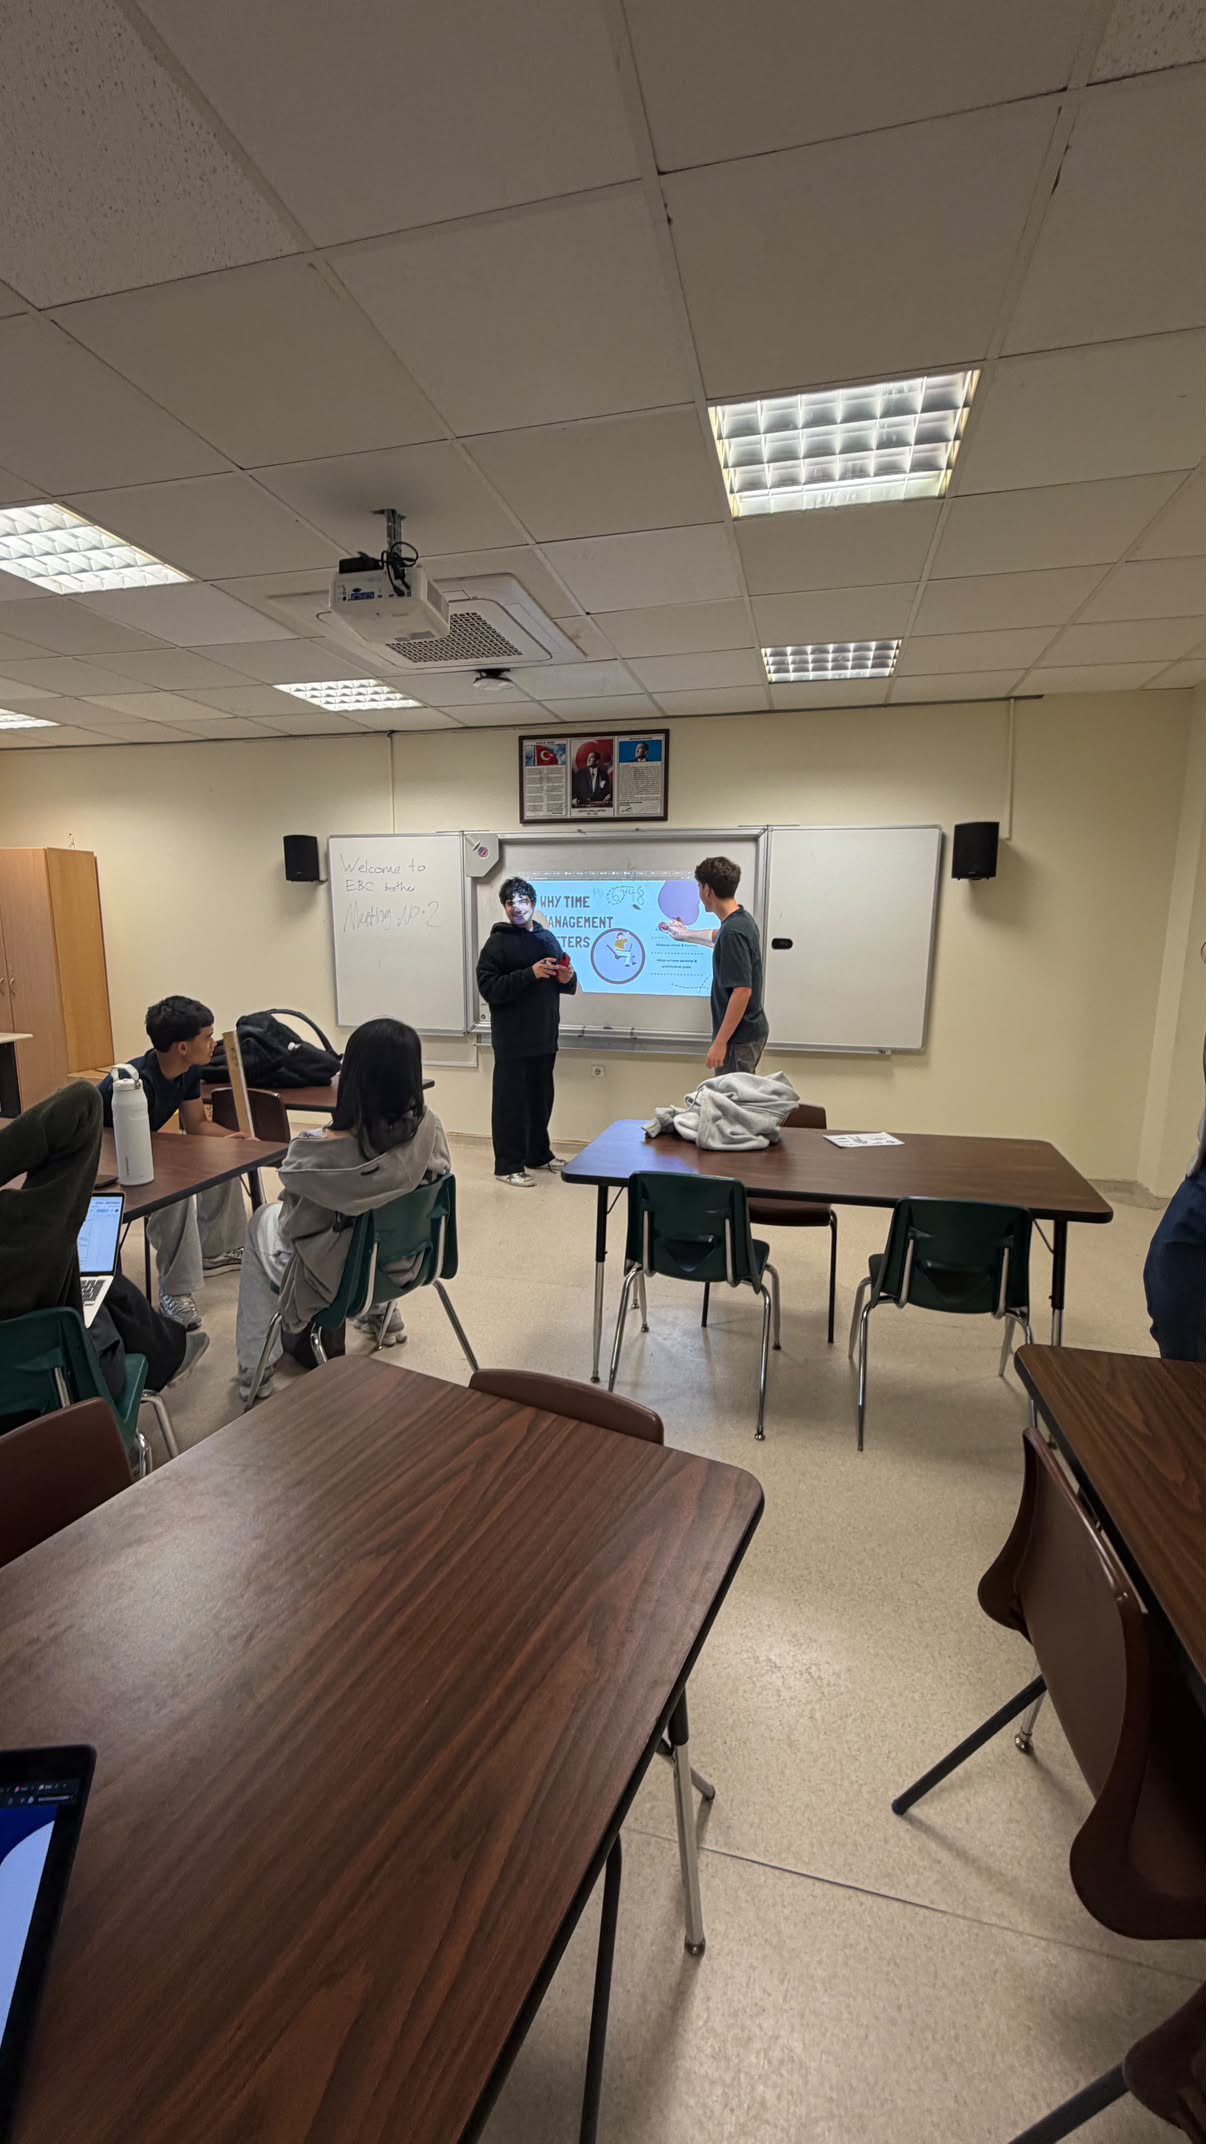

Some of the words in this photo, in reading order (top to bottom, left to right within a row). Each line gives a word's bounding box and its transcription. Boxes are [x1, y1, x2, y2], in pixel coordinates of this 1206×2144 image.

[340, 853, 401, 874] Welcome
[408, 858, 426, 873] to
[540, 895, 561, 908] WHY
[564, 896, 590, 908] TIME
[547, 916, 614, 929] ANAGEMENT
